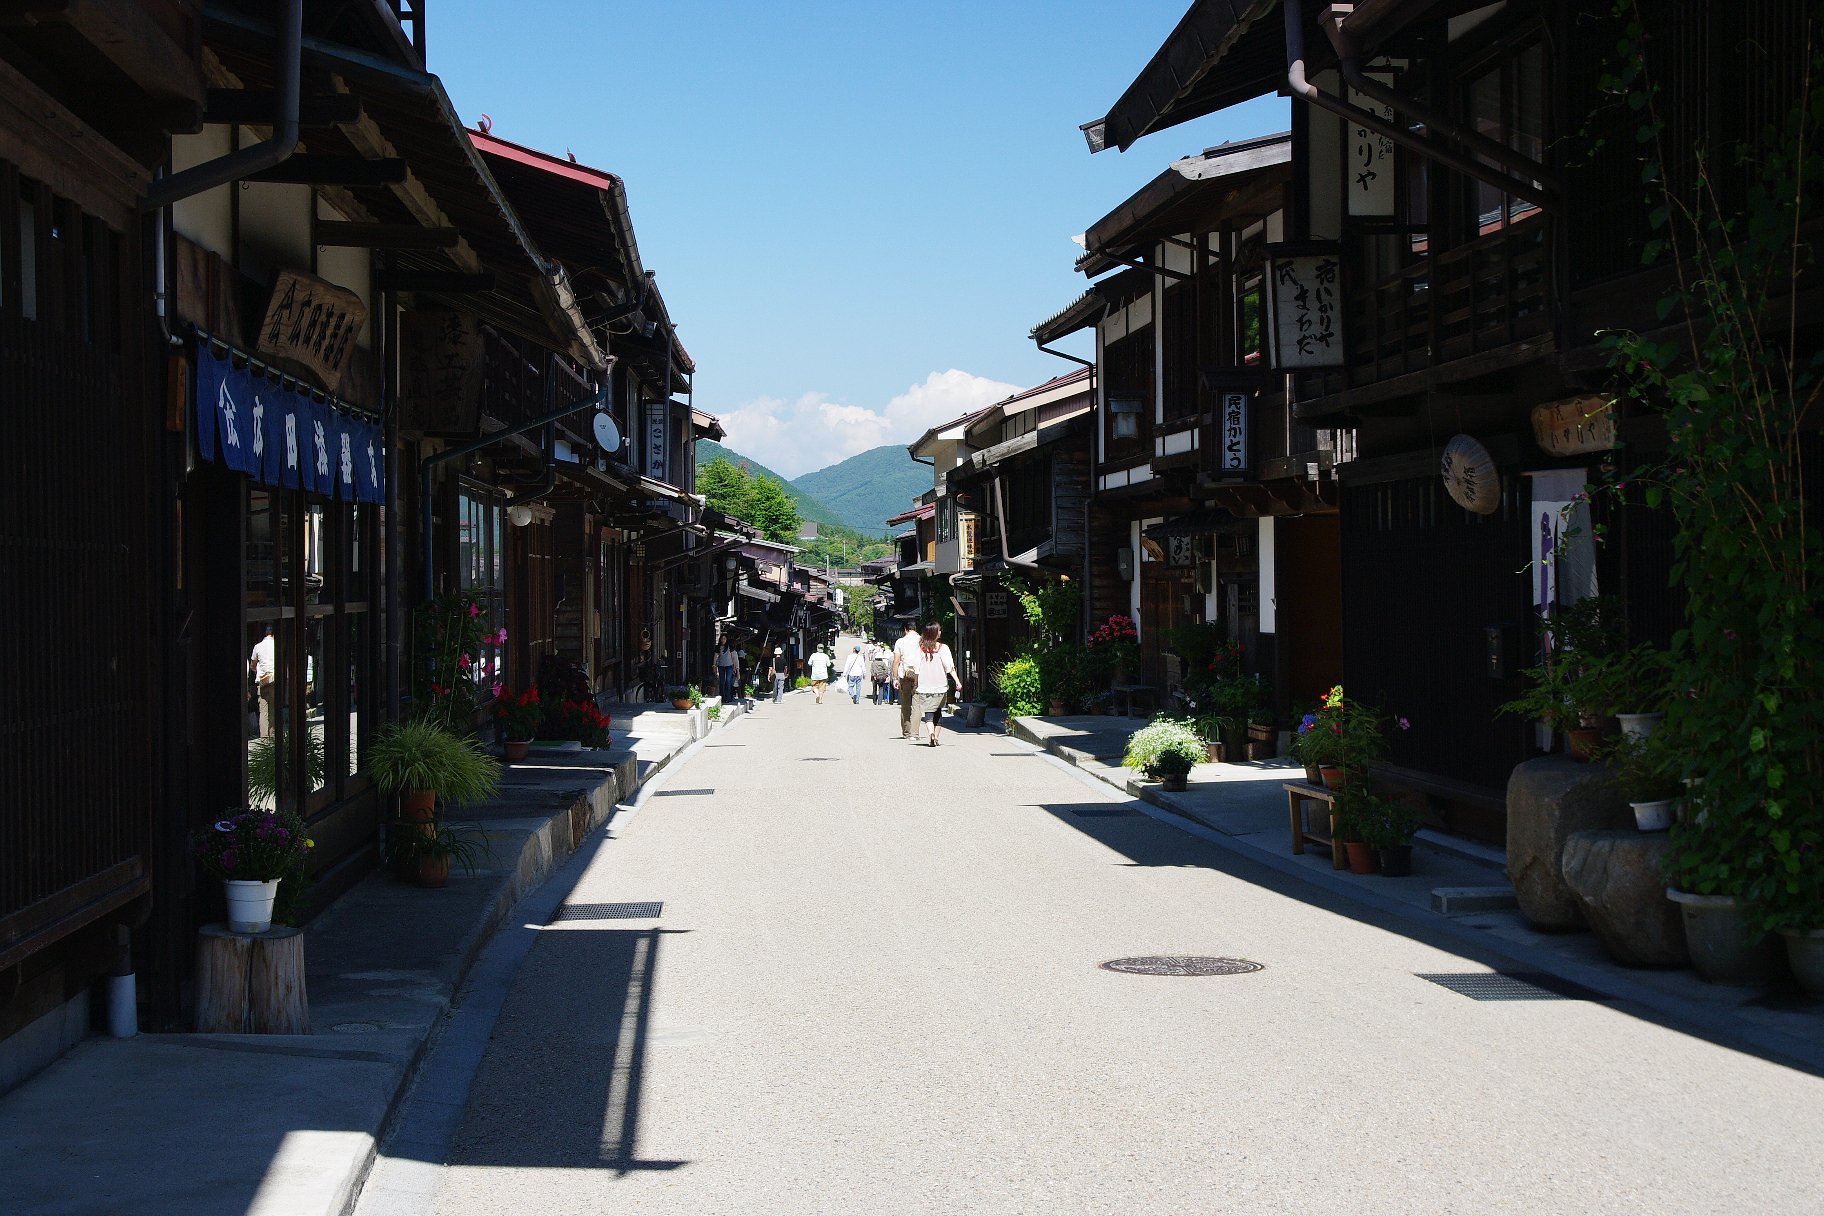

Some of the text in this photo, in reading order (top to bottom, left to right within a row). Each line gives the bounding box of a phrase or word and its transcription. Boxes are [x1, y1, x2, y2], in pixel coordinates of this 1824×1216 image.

[1226, 395, 1242, 469] 民宿かとう
